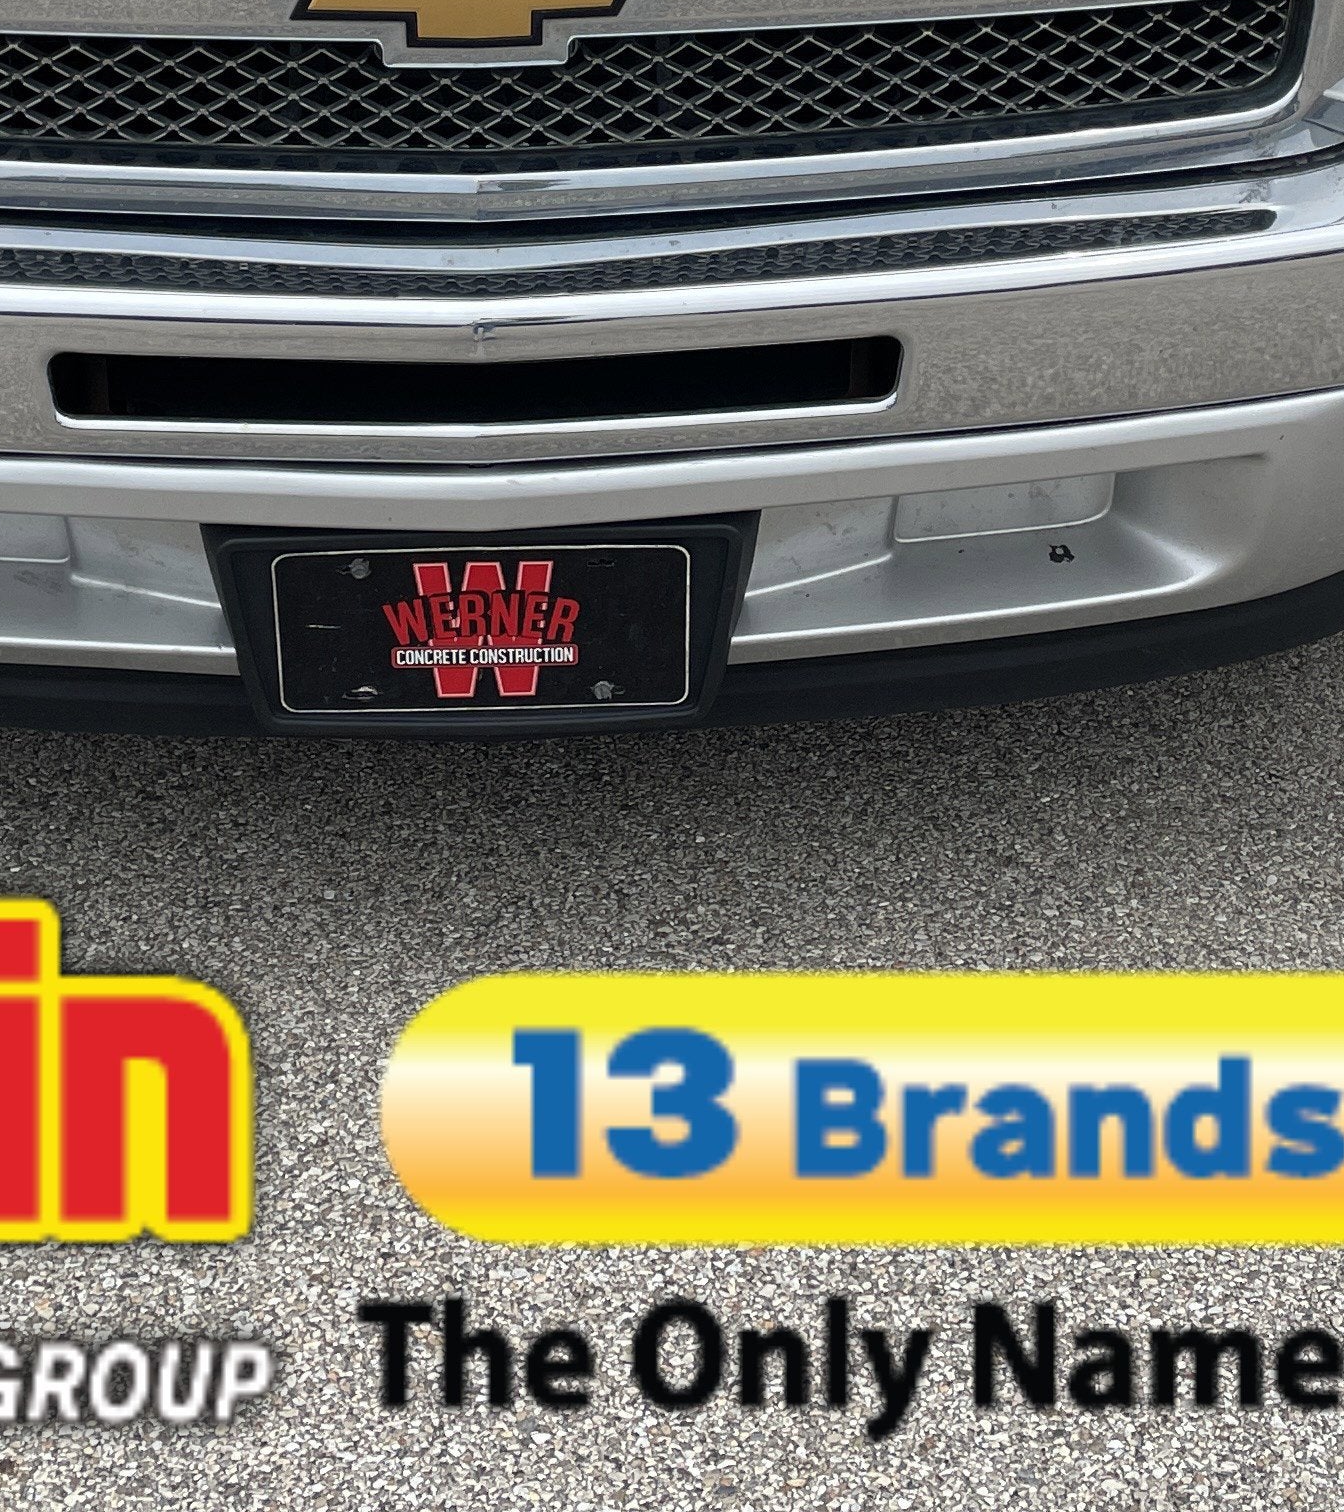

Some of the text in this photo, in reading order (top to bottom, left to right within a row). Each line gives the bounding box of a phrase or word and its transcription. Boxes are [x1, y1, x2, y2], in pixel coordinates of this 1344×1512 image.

[382, 592, 580, 645] WERNER
[396, 646, 574, 665] CONCRETE CONSTRUCTION
